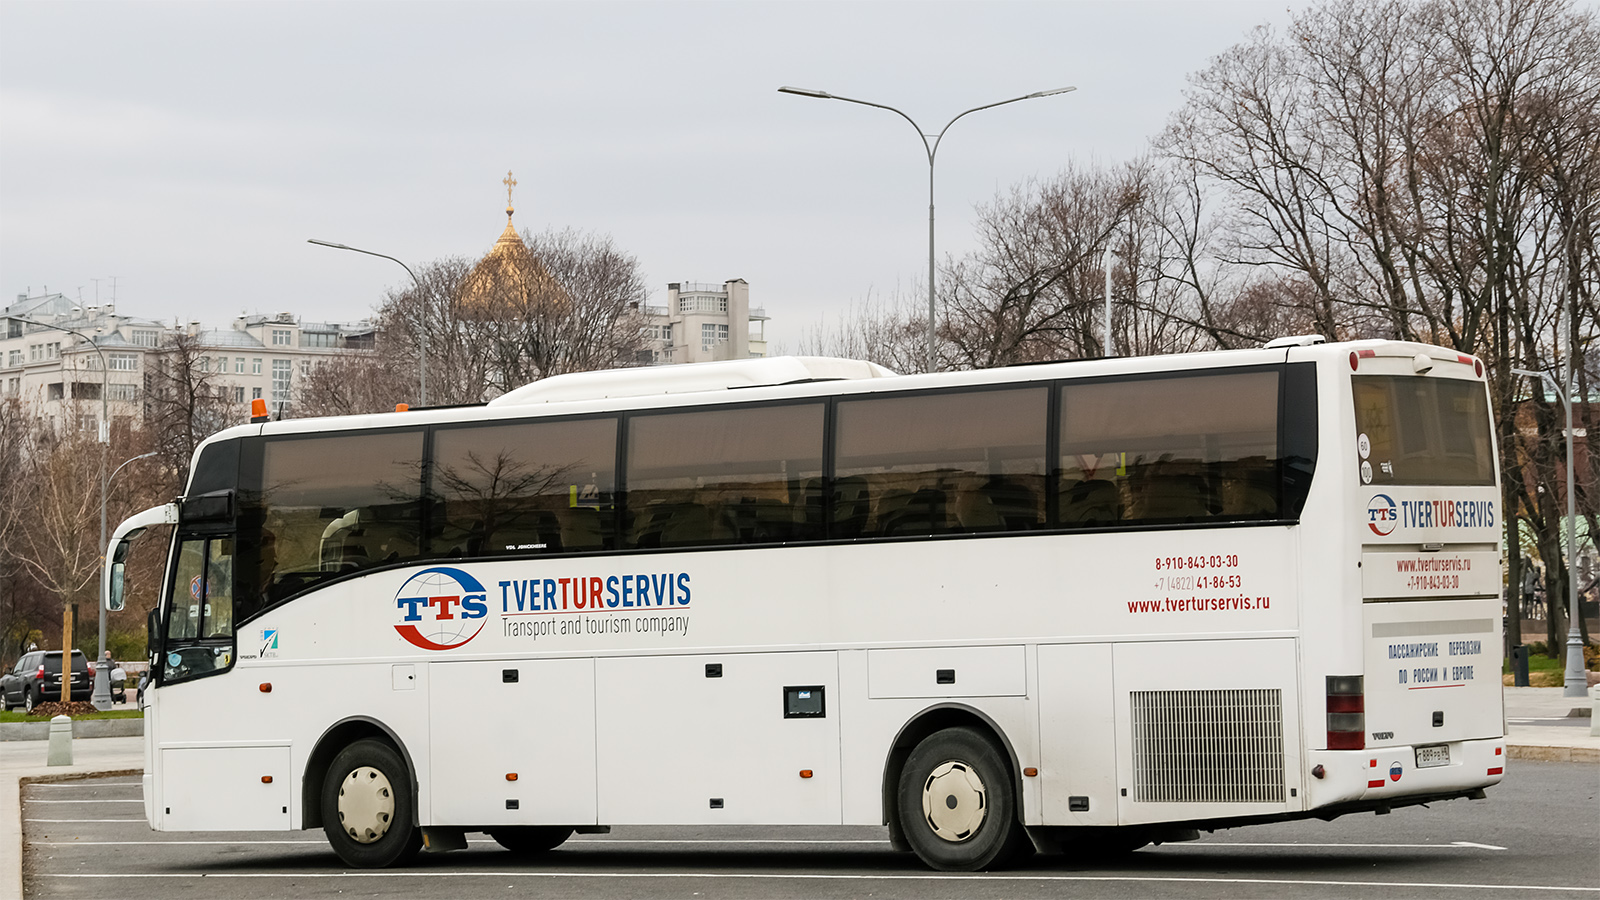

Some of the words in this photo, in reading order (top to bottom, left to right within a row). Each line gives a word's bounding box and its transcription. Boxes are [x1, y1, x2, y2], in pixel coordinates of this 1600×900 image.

[1368, 508, 1397, 521] TTS
[1402, 500, 1494, 528] TVERTURSERVIS
[1155, 554, 1239, 570] 8-910-843-03-30
[1397, 556, 1471, 572] www.tverturservis.ru
[498, 572, 691, 612] TVERTURSERVIS
[1154, 577, 1164, 590] +7
[1167, 575, 1194, 591] (4822)
[1196, 575, 1241, 589] 41-86-53
[1407, 575, 1459, 590] +7-910-843-03-30
[397, 594, 488, 622] TTS
[1127, 594, 1270, 613] www.tverturservis.ru
[502, 616, 557, 641] Transport
[560, 614, 582, 635] and
[586, 613, 631, 634] tourism
[635, 614, 690, 637] company
[1388, 642, 1438, 659] ПАССАЖИРСКИЕ
[1449, 640, 1481, 656] ПЕРЕВОЗКИ
[1399, 669, 1408, 684] ПО
[1413, 667, 1438, 683] РОССИИ
[1453, 665, 1474, 681] ЕВРОПЕ
[1372, 731, 1394, 740] VOLVO
